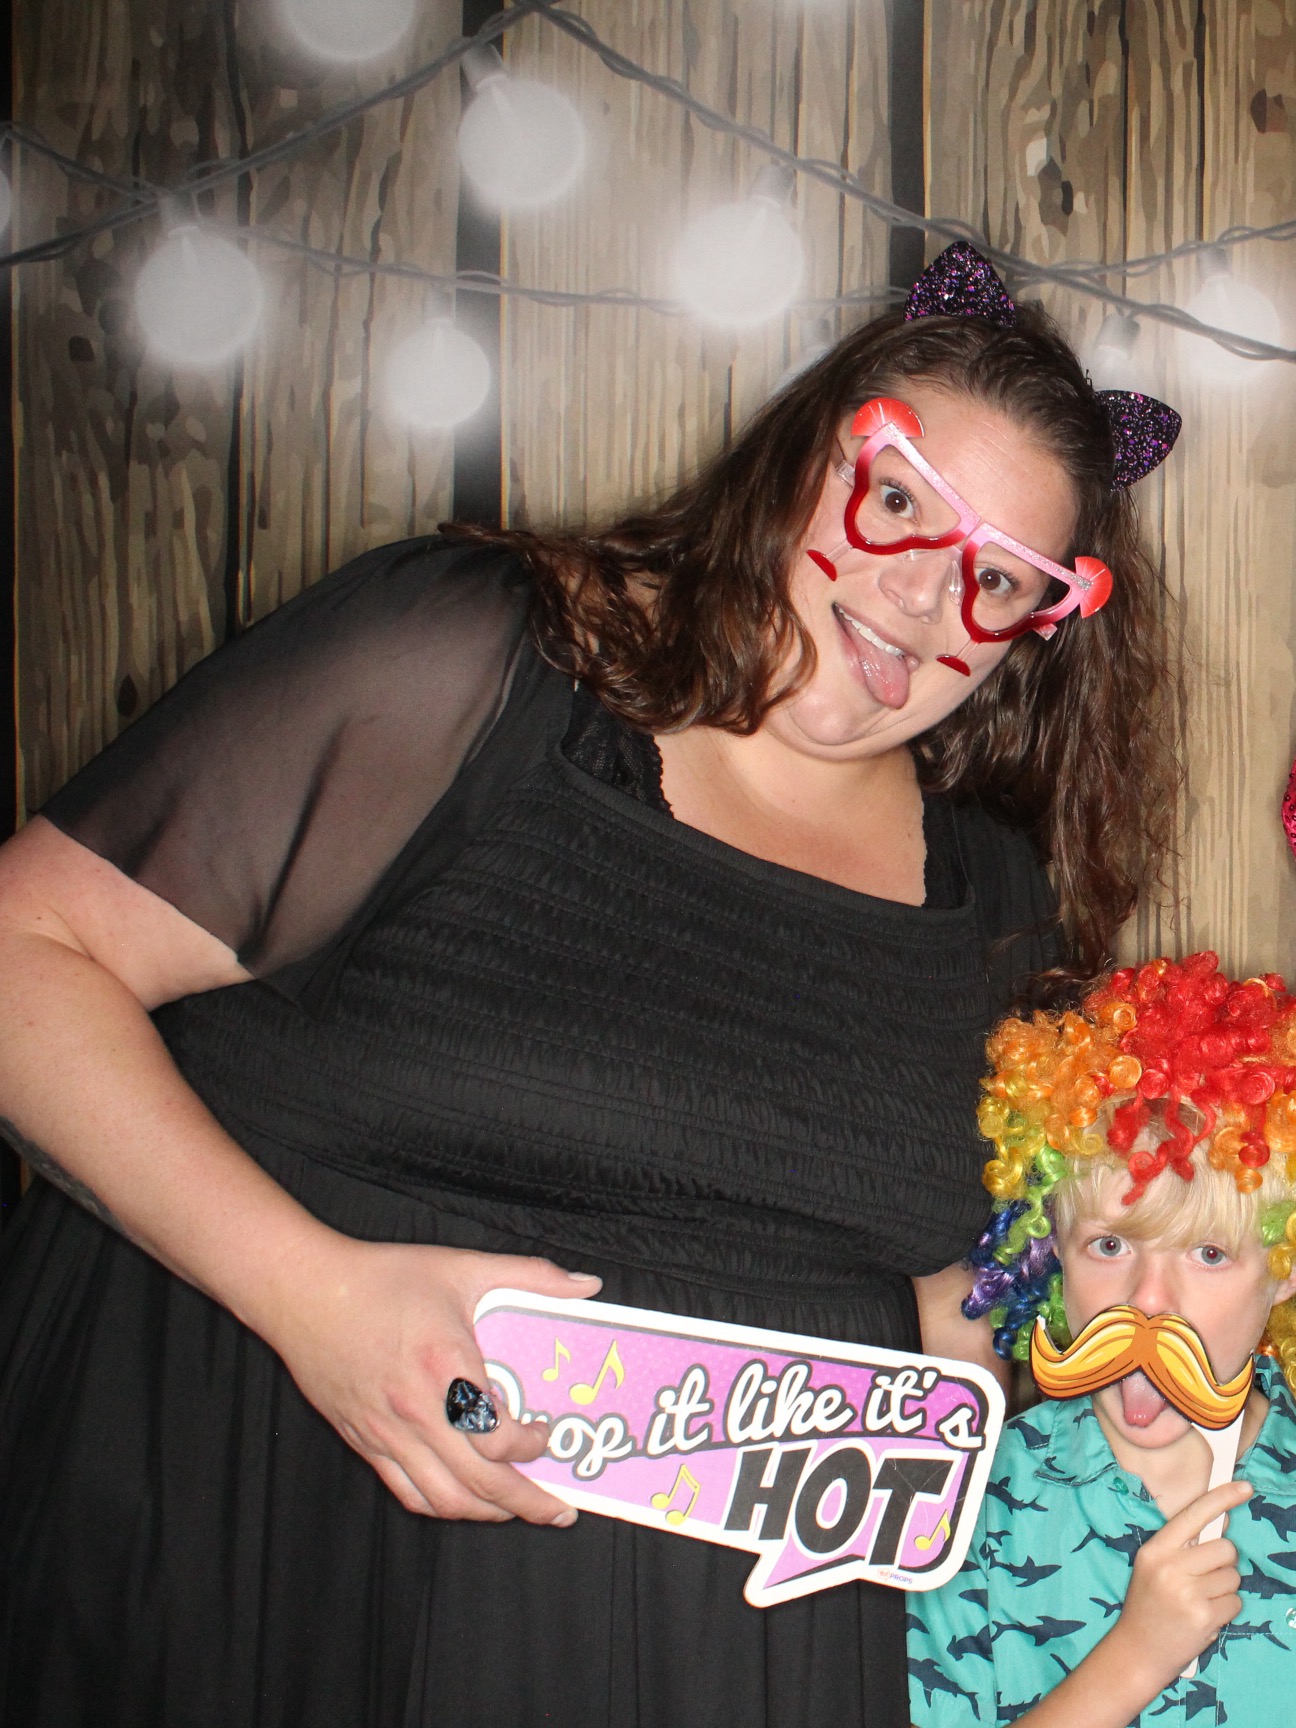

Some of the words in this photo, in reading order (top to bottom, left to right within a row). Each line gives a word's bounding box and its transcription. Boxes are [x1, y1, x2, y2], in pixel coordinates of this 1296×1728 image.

[484, 1362, 633, 1477] op
[649, 1368, 709, 1455] it
[727, 1364, 852, 1442] like
[864, 1368, 984, 1450] it's
[723, 1443, 954, 1567] HOT
